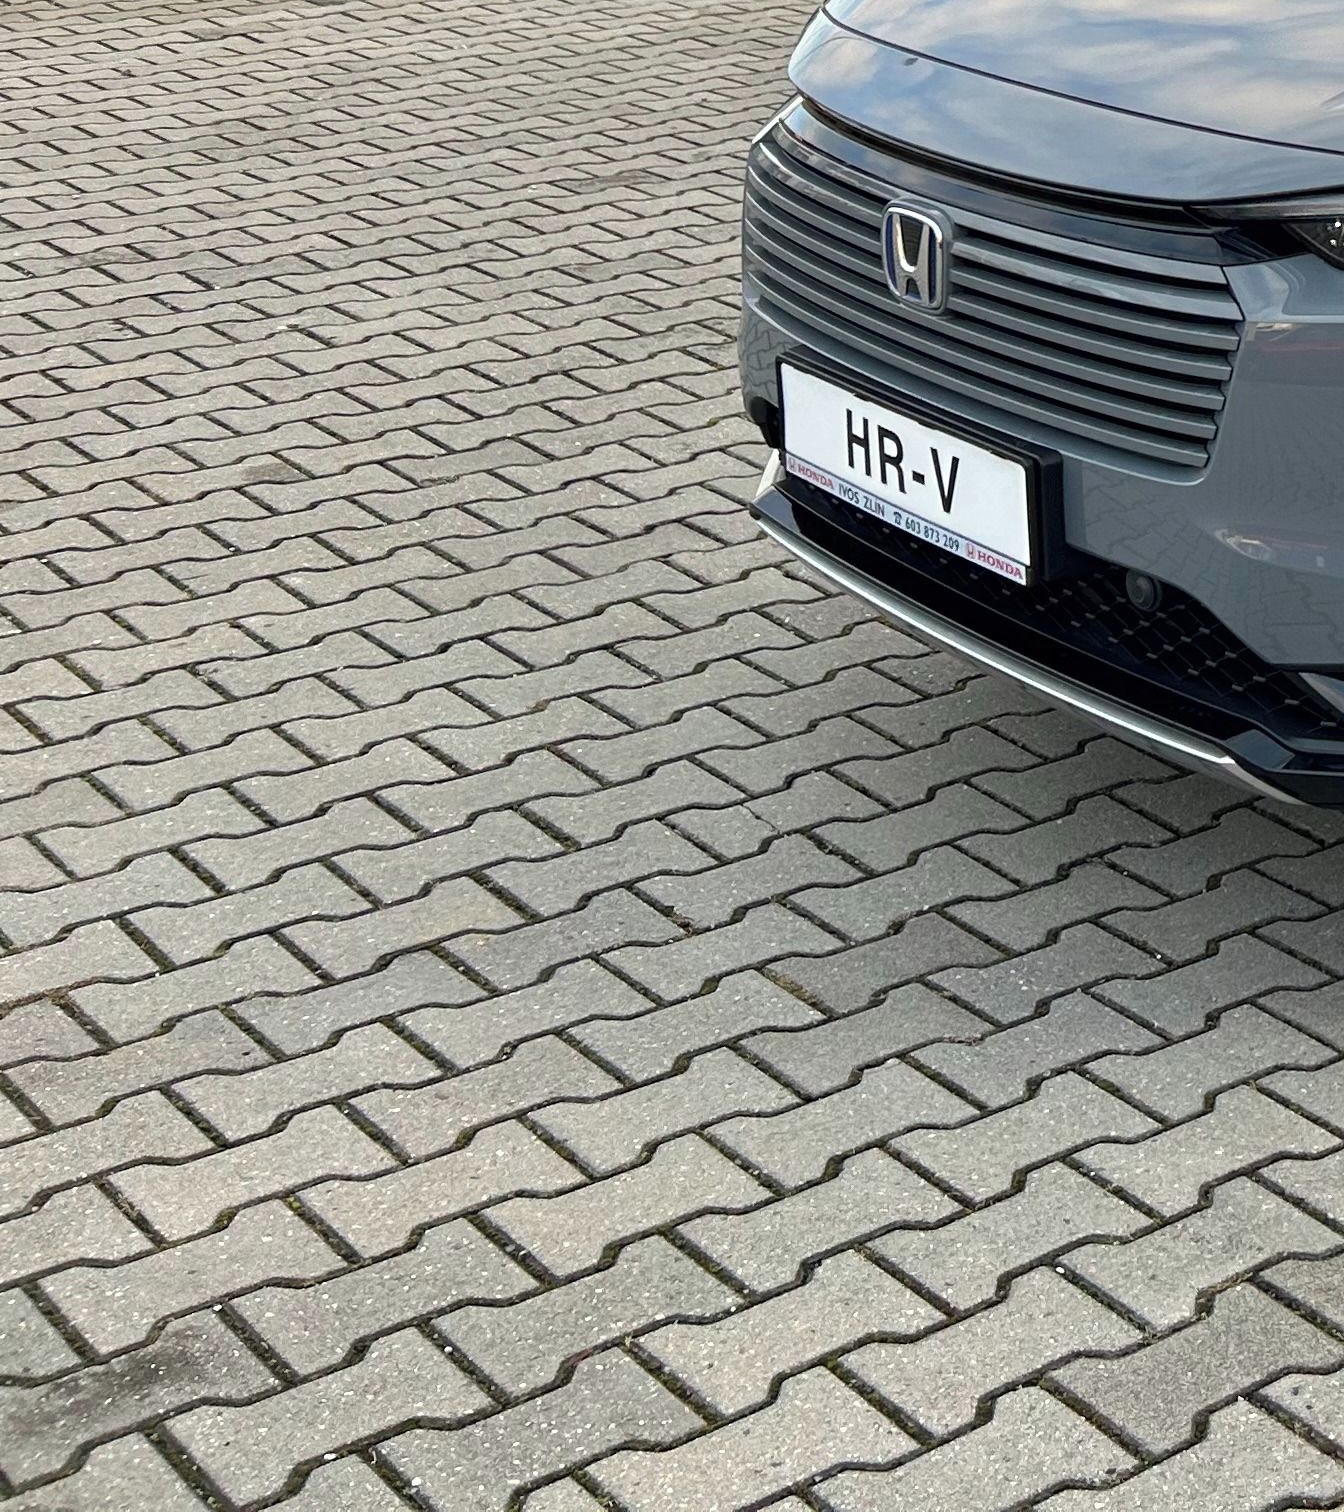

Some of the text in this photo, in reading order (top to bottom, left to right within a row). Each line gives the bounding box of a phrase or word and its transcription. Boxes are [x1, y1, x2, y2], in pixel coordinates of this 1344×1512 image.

[846, 408, 959, 513] HR-V
[797, 464, 834, 489] HONDA
[838, 482, 860, 505] IVOS
[905, 518, 921, 534] 603
[924, 525, 940, 543] 873
[942, 533, 959, 552] 209
[977, 550, 1024, 580] HONDA
